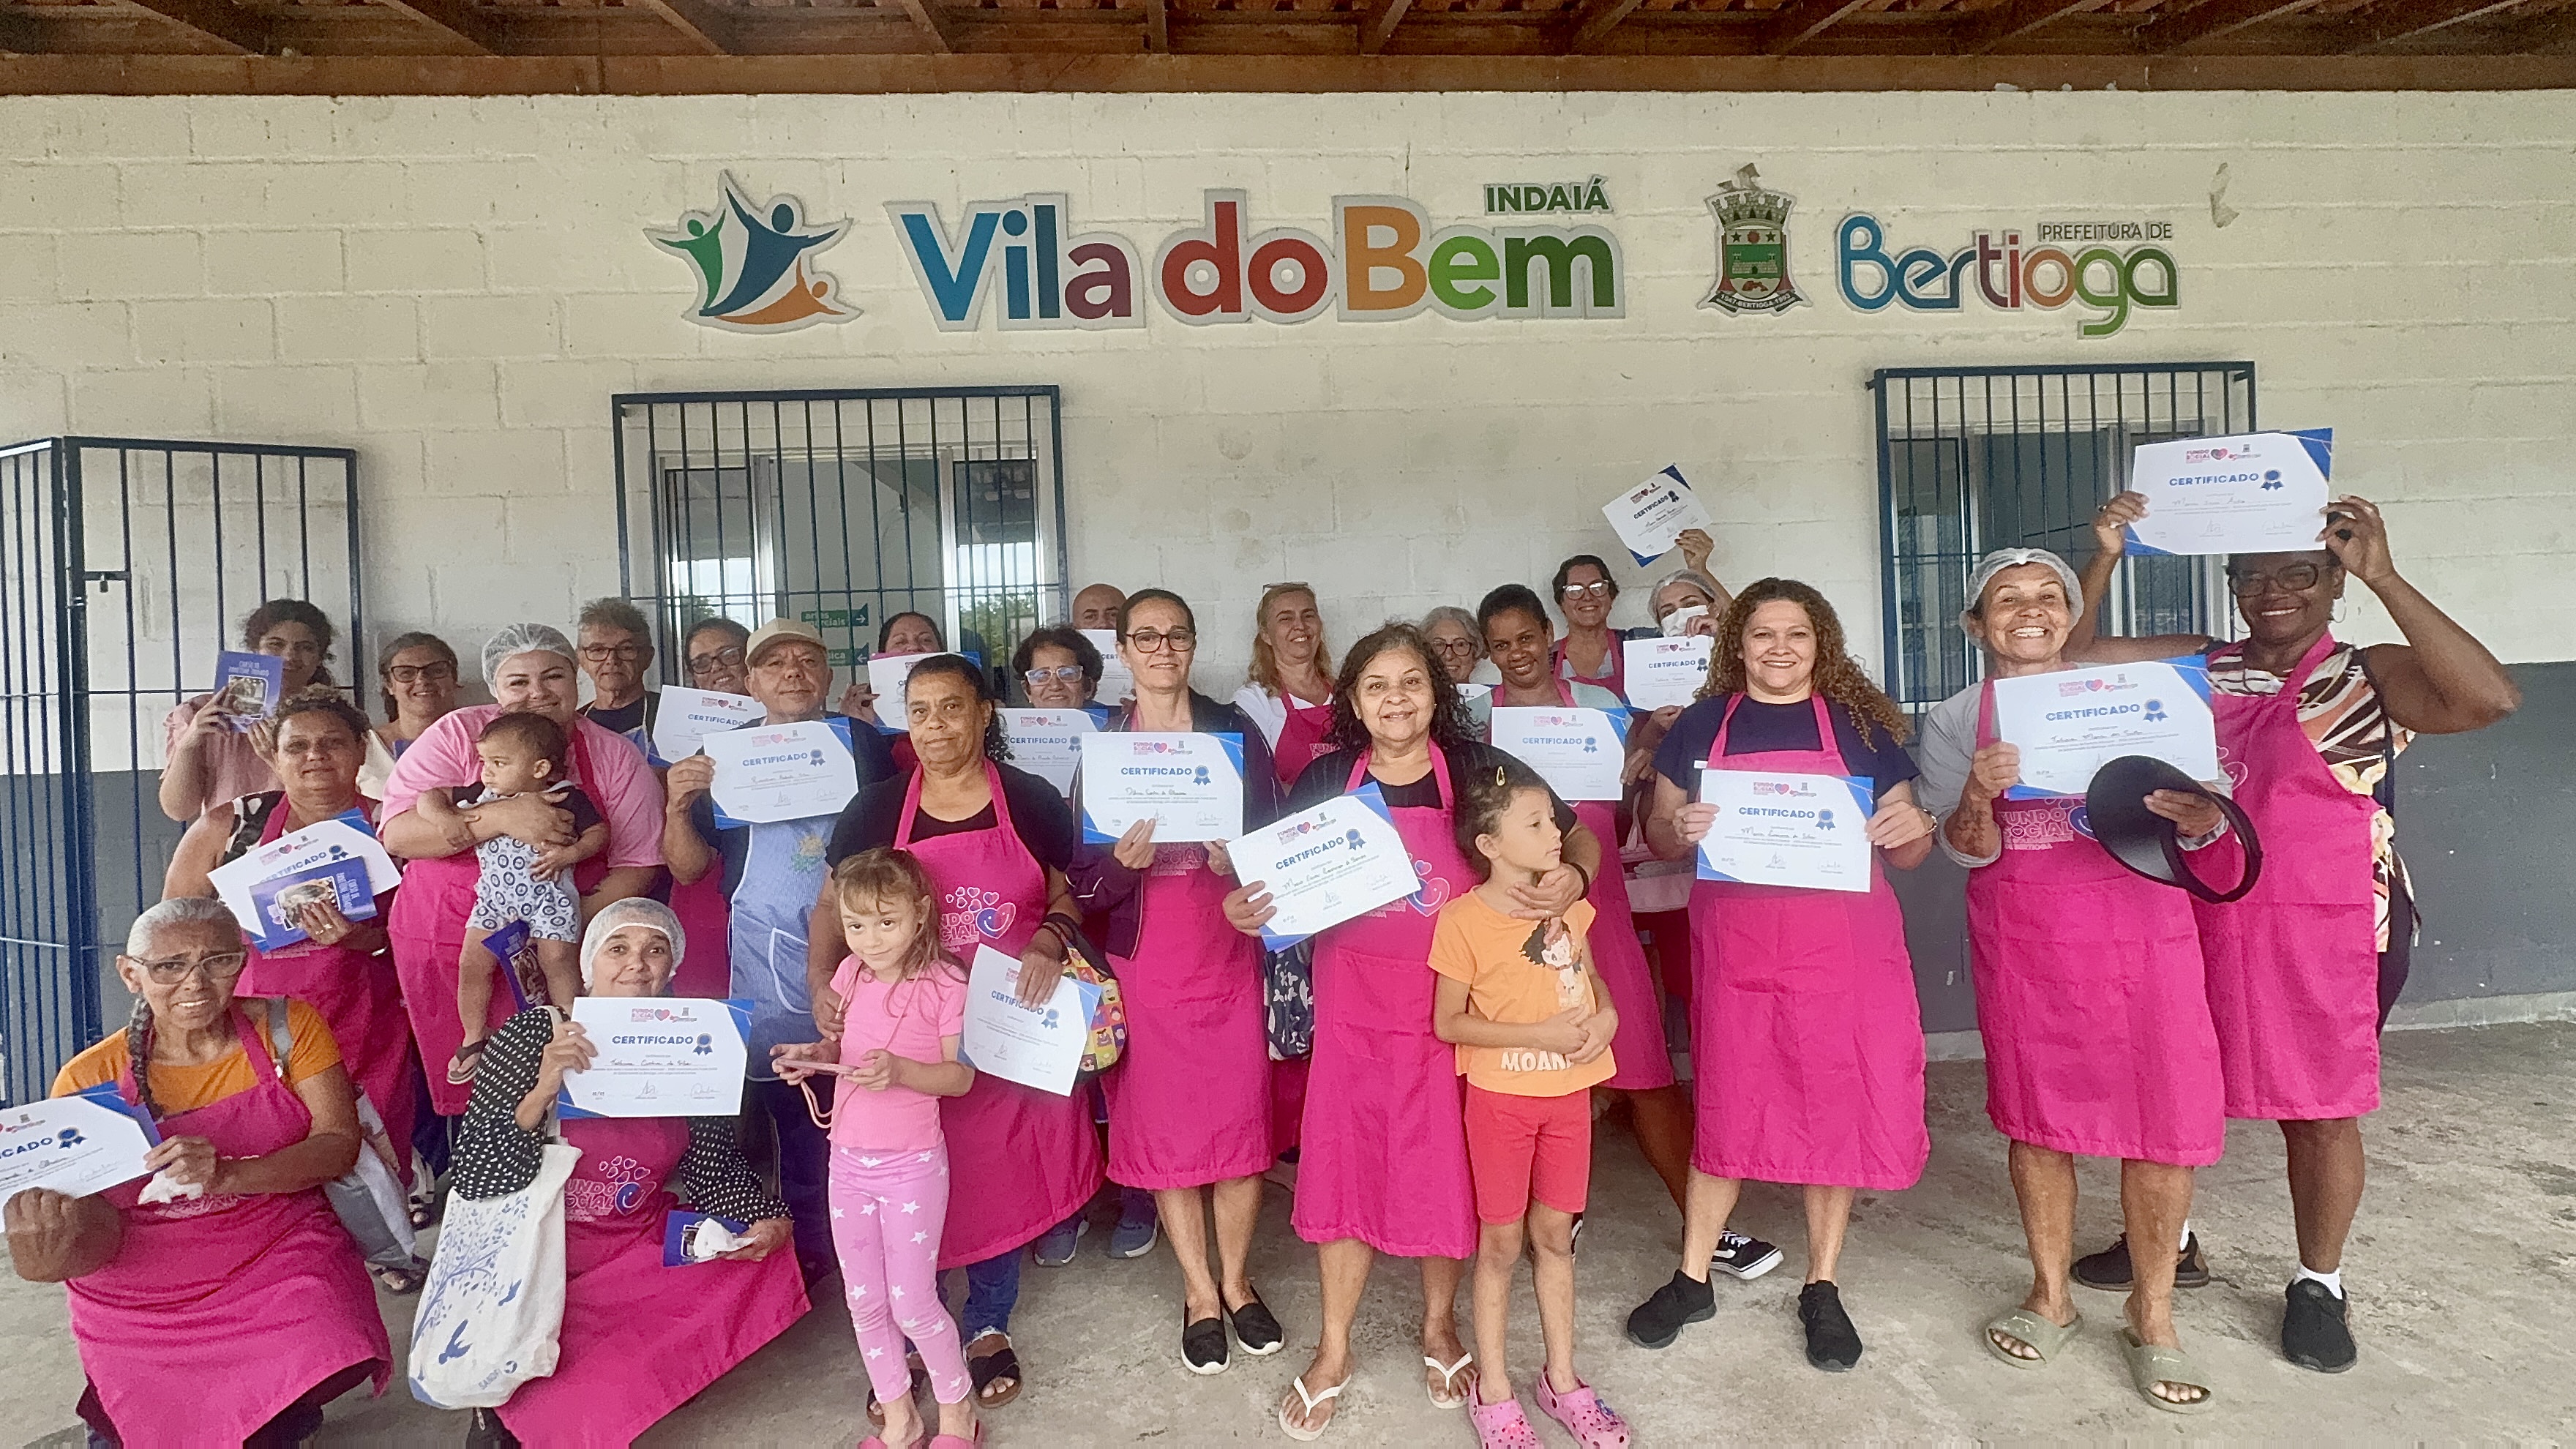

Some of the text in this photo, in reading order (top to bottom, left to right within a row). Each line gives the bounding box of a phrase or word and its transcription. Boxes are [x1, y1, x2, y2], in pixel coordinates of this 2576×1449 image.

[1487, 177, 1609, 212] INDAIÁ
[2043, 223, 2172, 240] PREFEITURA DE
[901, 201, 1616, 321] Vila do Bem
[1841, 216, 2178, 335] Bertioga
[2169, 473, 2259, 487] CERTIFICADO
[1648, 659, 1696, 668] CERTIFICADO
[688, 714, 744, 727] CERTIFICADO
[2045, 703, 2141, 722] CERTIFICADO
[1522, 737, 1582, 745] CERTIFICADO
[742, 752, 808, 767] CERTIFICADO
[1120, 767, 1192, 776] CERTIFICADO
[1738, 806, 1816, 819] CERTIFICADO
[1276, 836, 1344, 870] CERTIFICADO
[991, 990, 1044, 1016] CERTIFICO
[612, 1036, 694, 1045] CERTIFICADO
[565, 1178, 618, 1197] UNDO
[565, 1193, 615, 1209] OCIAL
